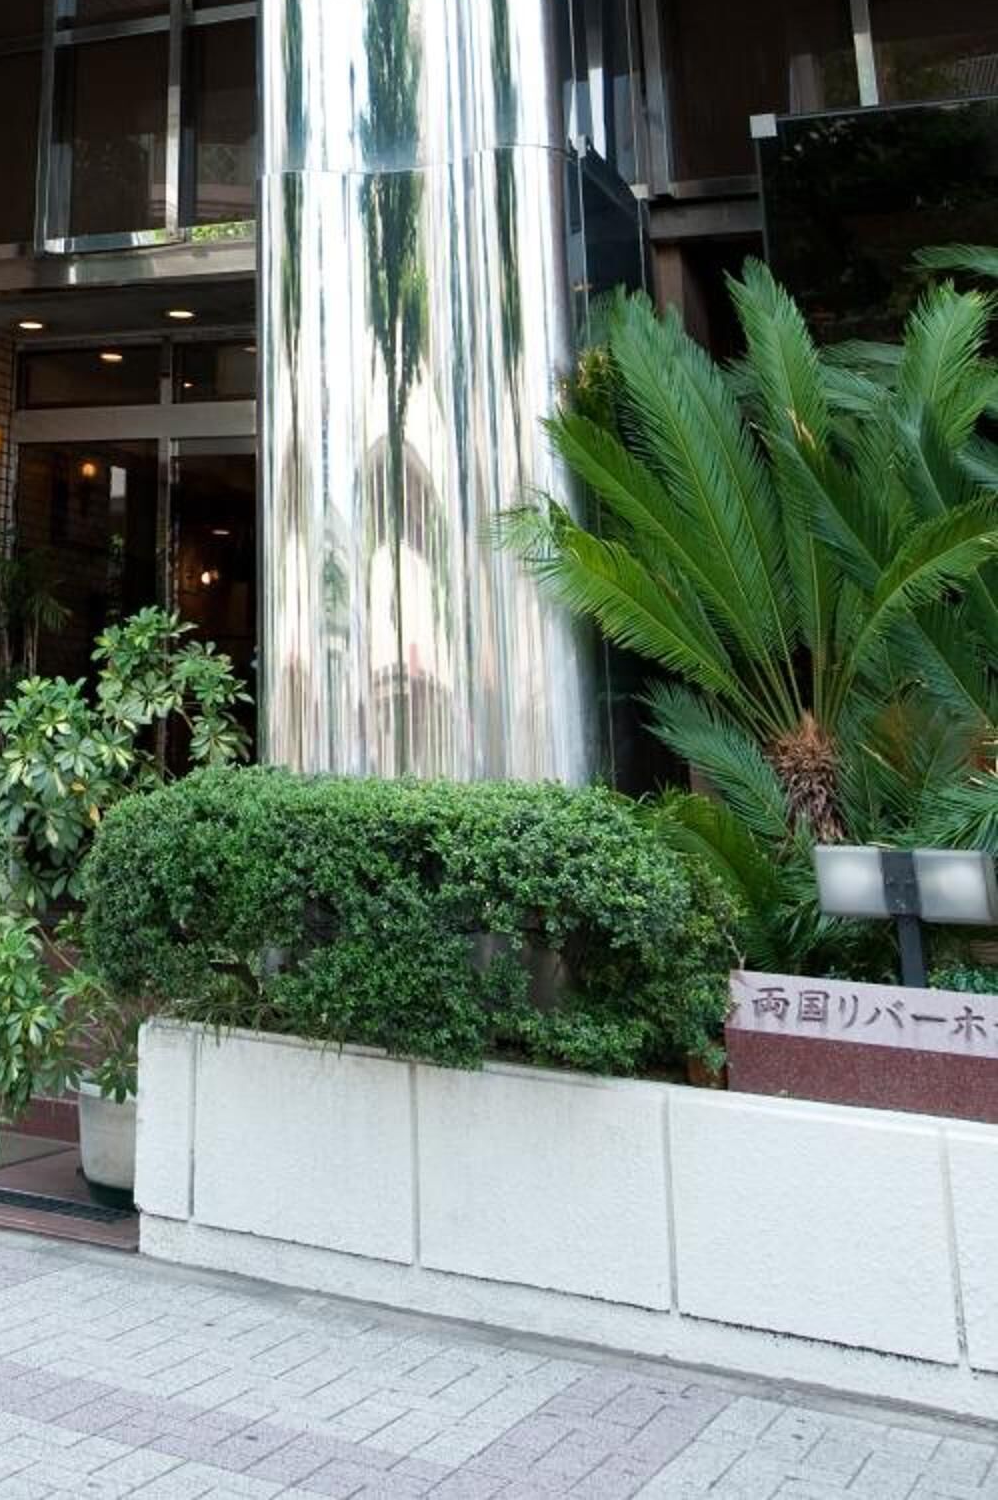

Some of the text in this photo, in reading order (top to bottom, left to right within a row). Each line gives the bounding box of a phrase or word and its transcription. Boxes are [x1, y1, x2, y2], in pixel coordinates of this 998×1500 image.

[751, 986, 998, 1042] 両国リバーホ
